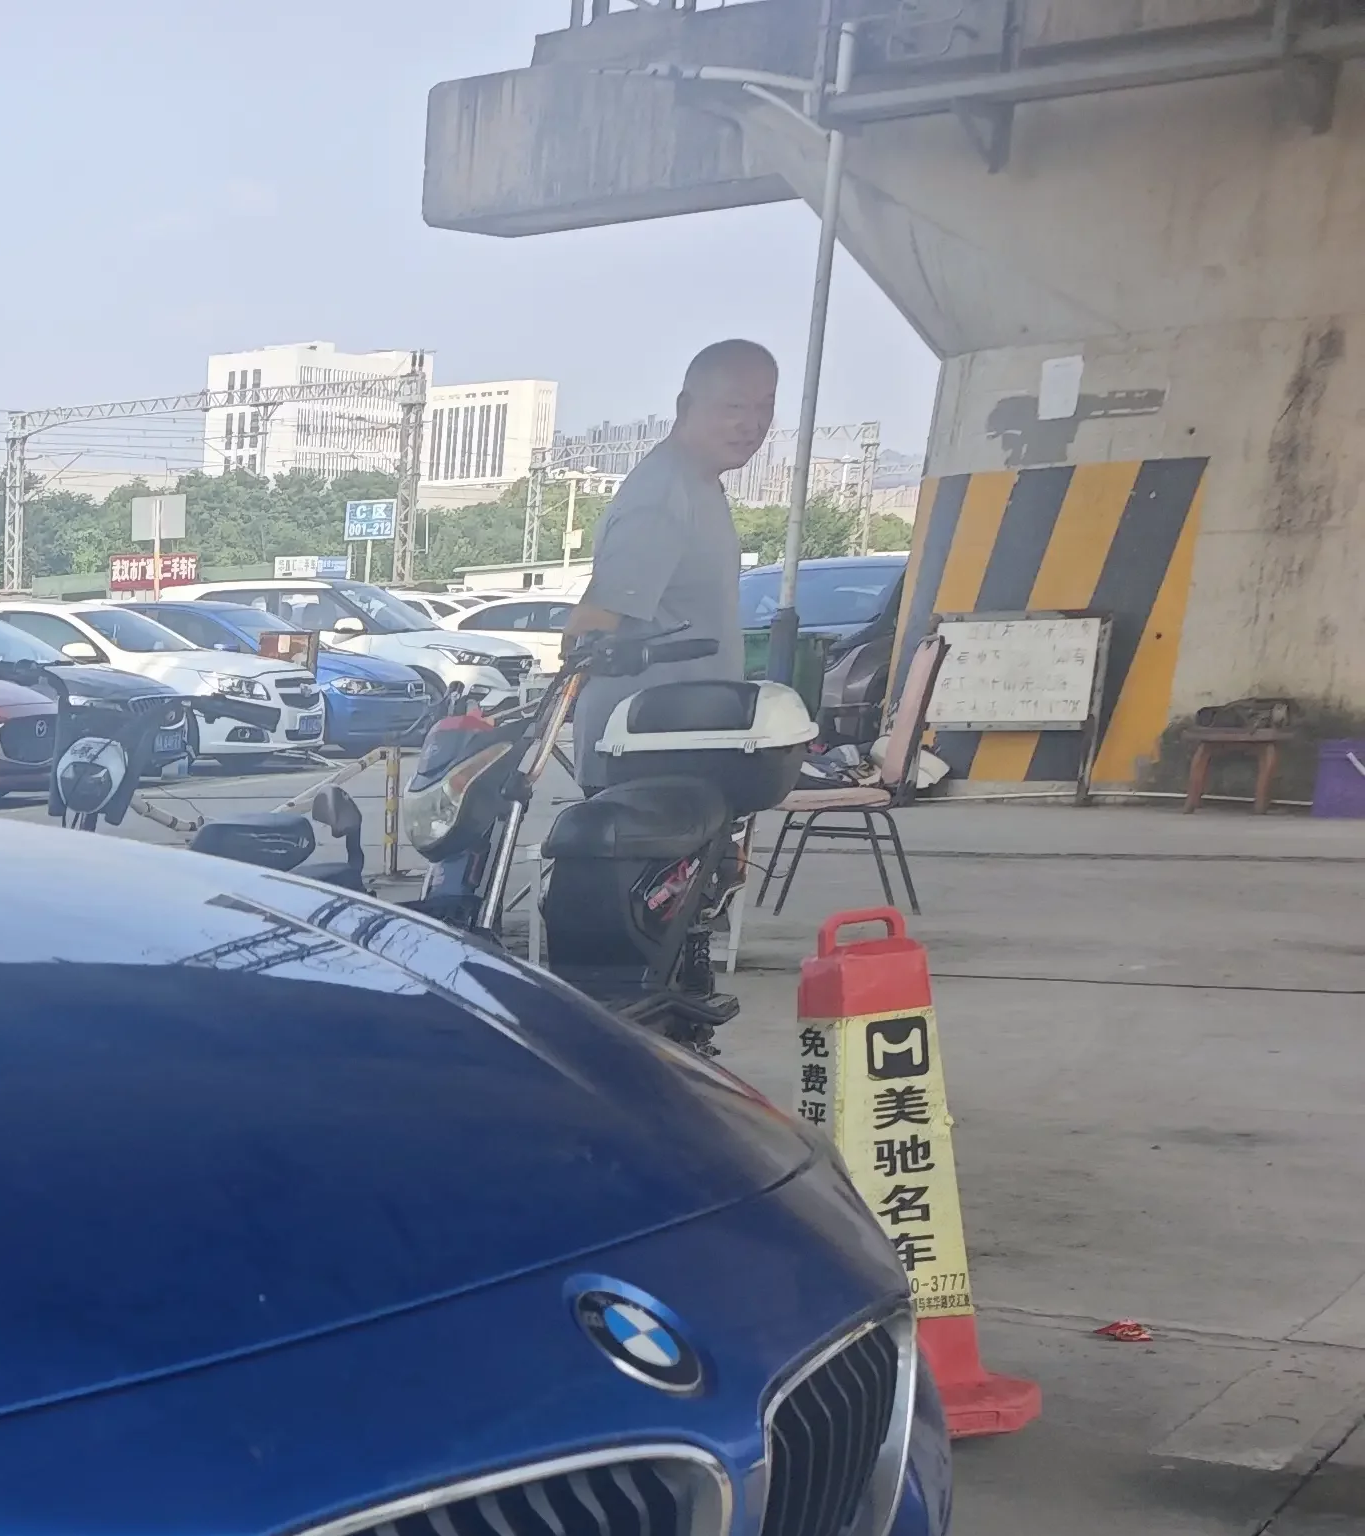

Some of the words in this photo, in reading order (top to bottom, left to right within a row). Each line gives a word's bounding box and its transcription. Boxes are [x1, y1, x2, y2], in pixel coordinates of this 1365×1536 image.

[348, 522, 391, 537] 001-212
[798, 1027, 829, 1126] 免费评
[873, 1086, 938, 1273] 美驰名车
[910, 1272, 967, 1294] 0-3777
